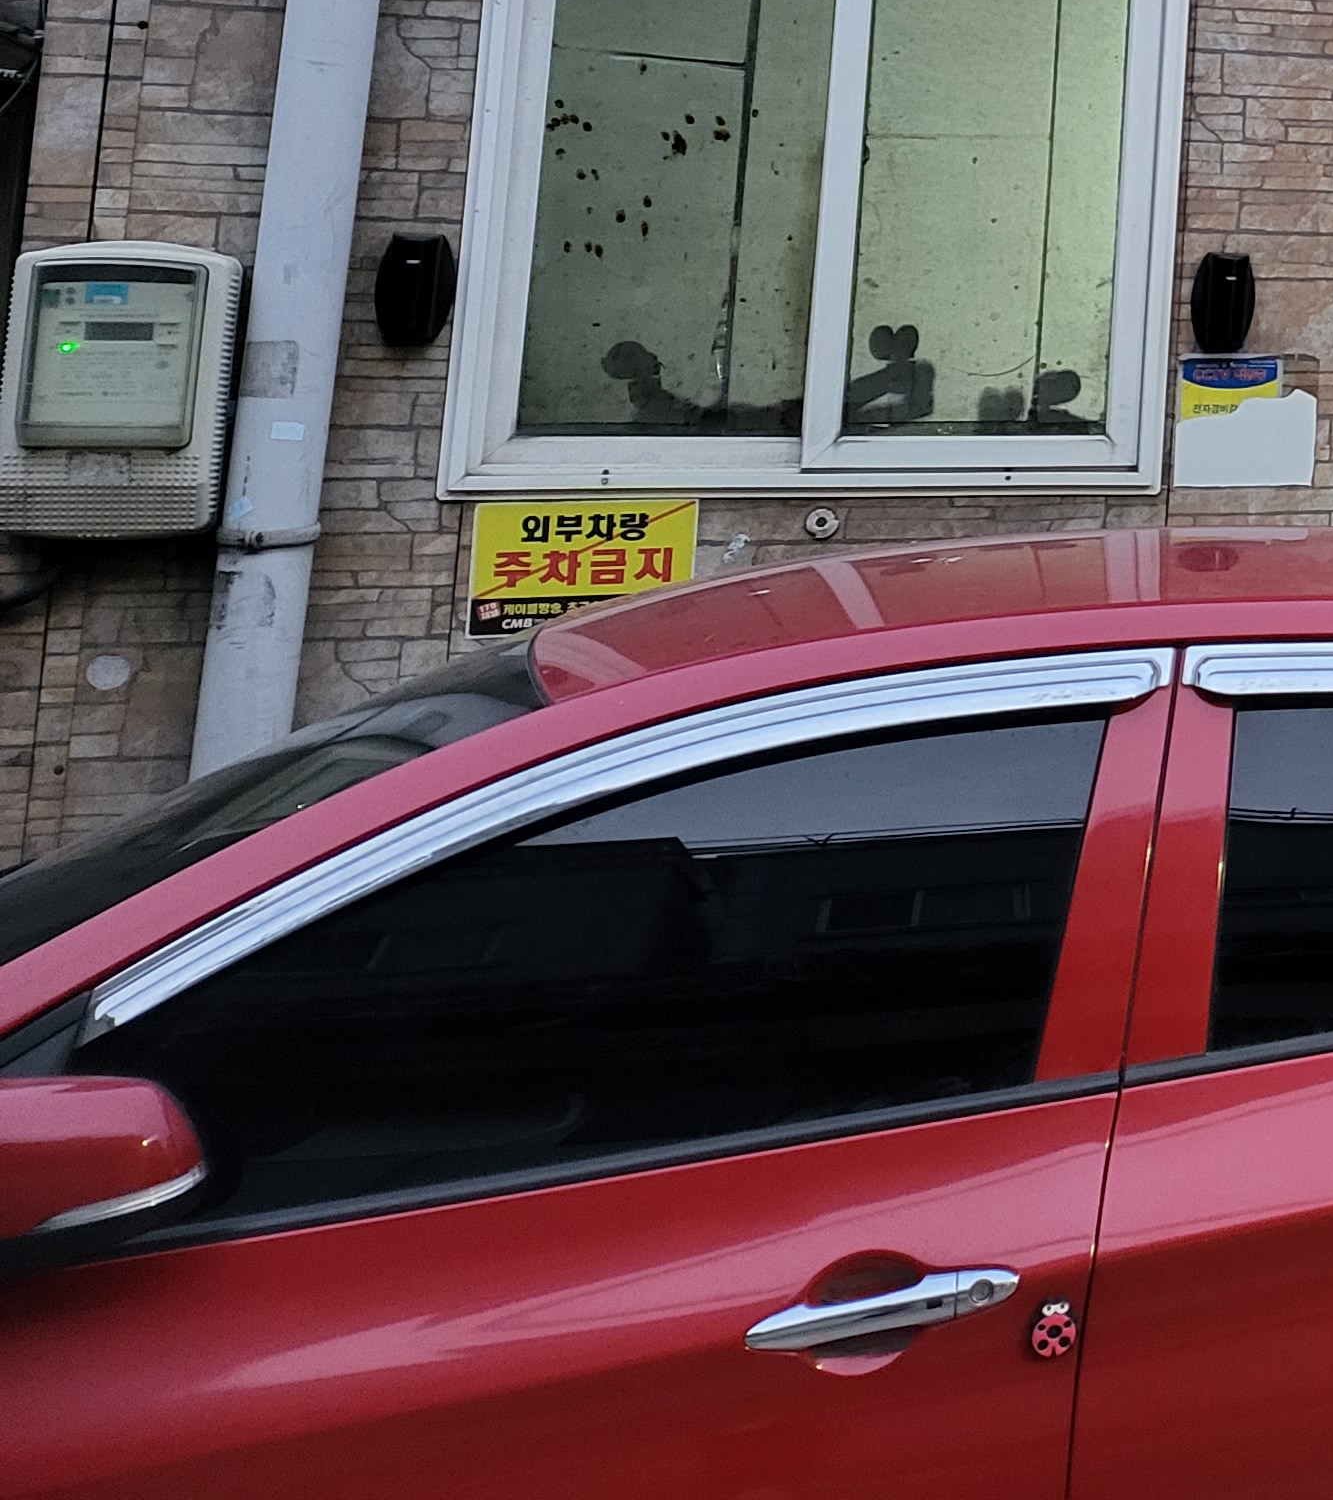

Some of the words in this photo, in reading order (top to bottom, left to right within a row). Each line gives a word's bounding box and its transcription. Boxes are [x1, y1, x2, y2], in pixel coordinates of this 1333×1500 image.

[520, 513, 649, 543] 외부차량
[493, 548, 674, 588] 주차금지
[501, 618, 533, 629] CMB
